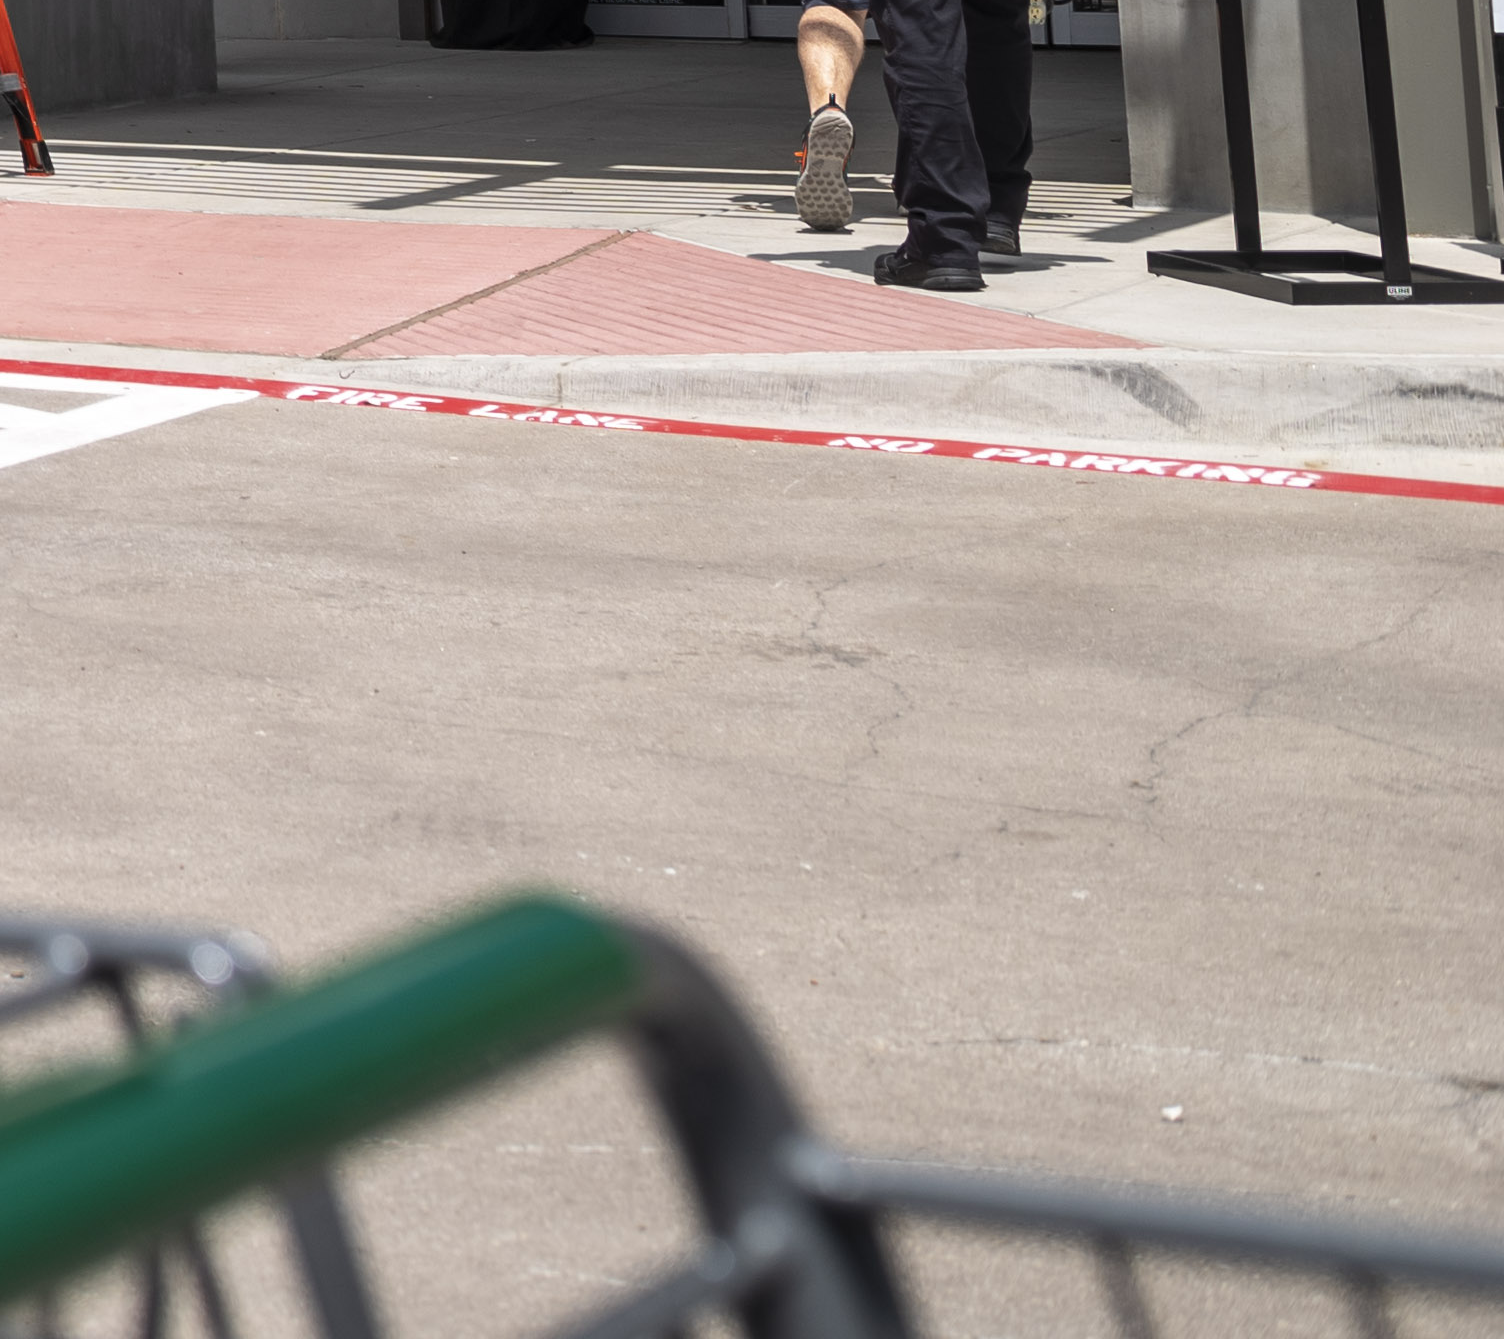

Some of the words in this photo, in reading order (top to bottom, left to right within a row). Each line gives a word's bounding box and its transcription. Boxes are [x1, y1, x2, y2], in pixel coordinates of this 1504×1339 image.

[284, 384, 446, 414] FIRE
[468, 402, 647, 433] LANE
[827, 434, 937, 455] NO
[971, 446, 1324, 491] PARKING
